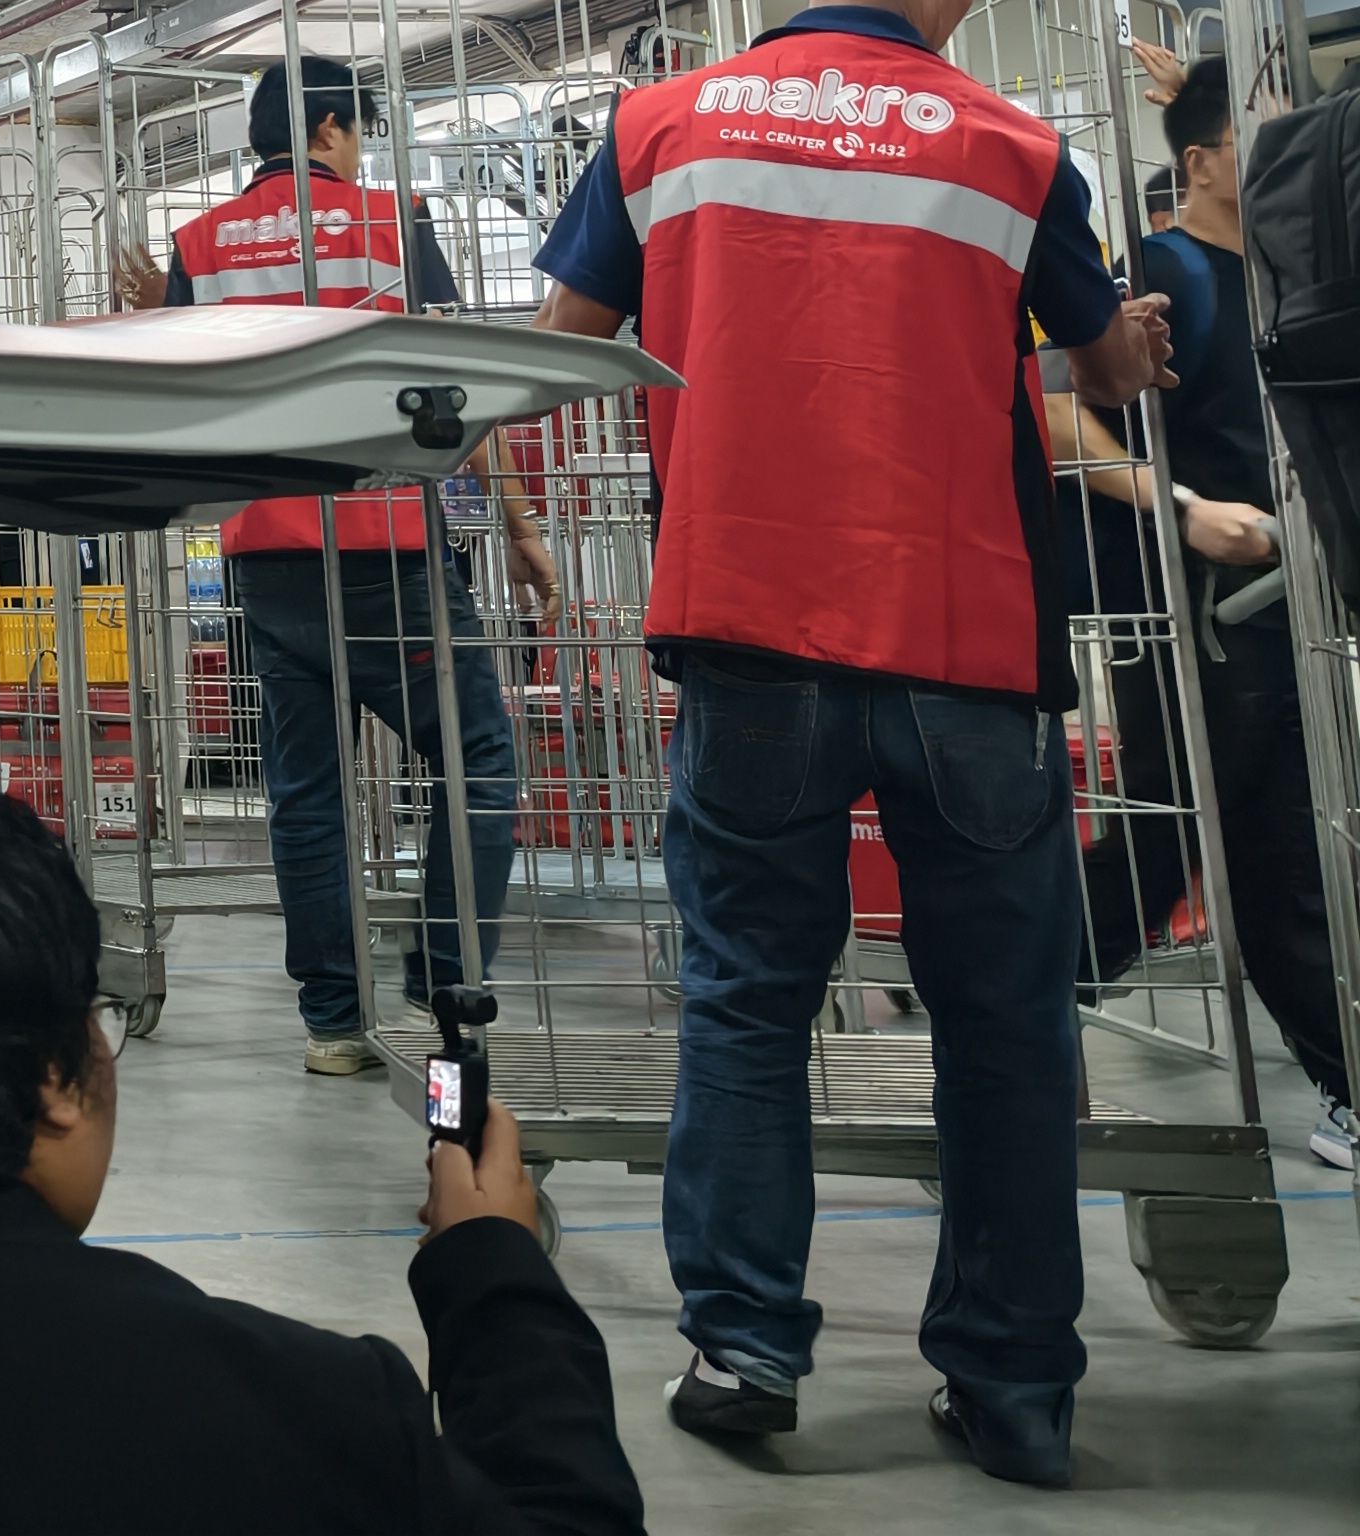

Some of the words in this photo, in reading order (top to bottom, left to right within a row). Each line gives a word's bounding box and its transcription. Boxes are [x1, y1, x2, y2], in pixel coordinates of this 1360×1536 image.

[695, 68, 955, 134] makro
[719, 128, 760, 141] CALL
[765, 131, 827, 150] CENTER
[868, 143, 907, 157] 1432
[102, 797, 136, 812] 151
